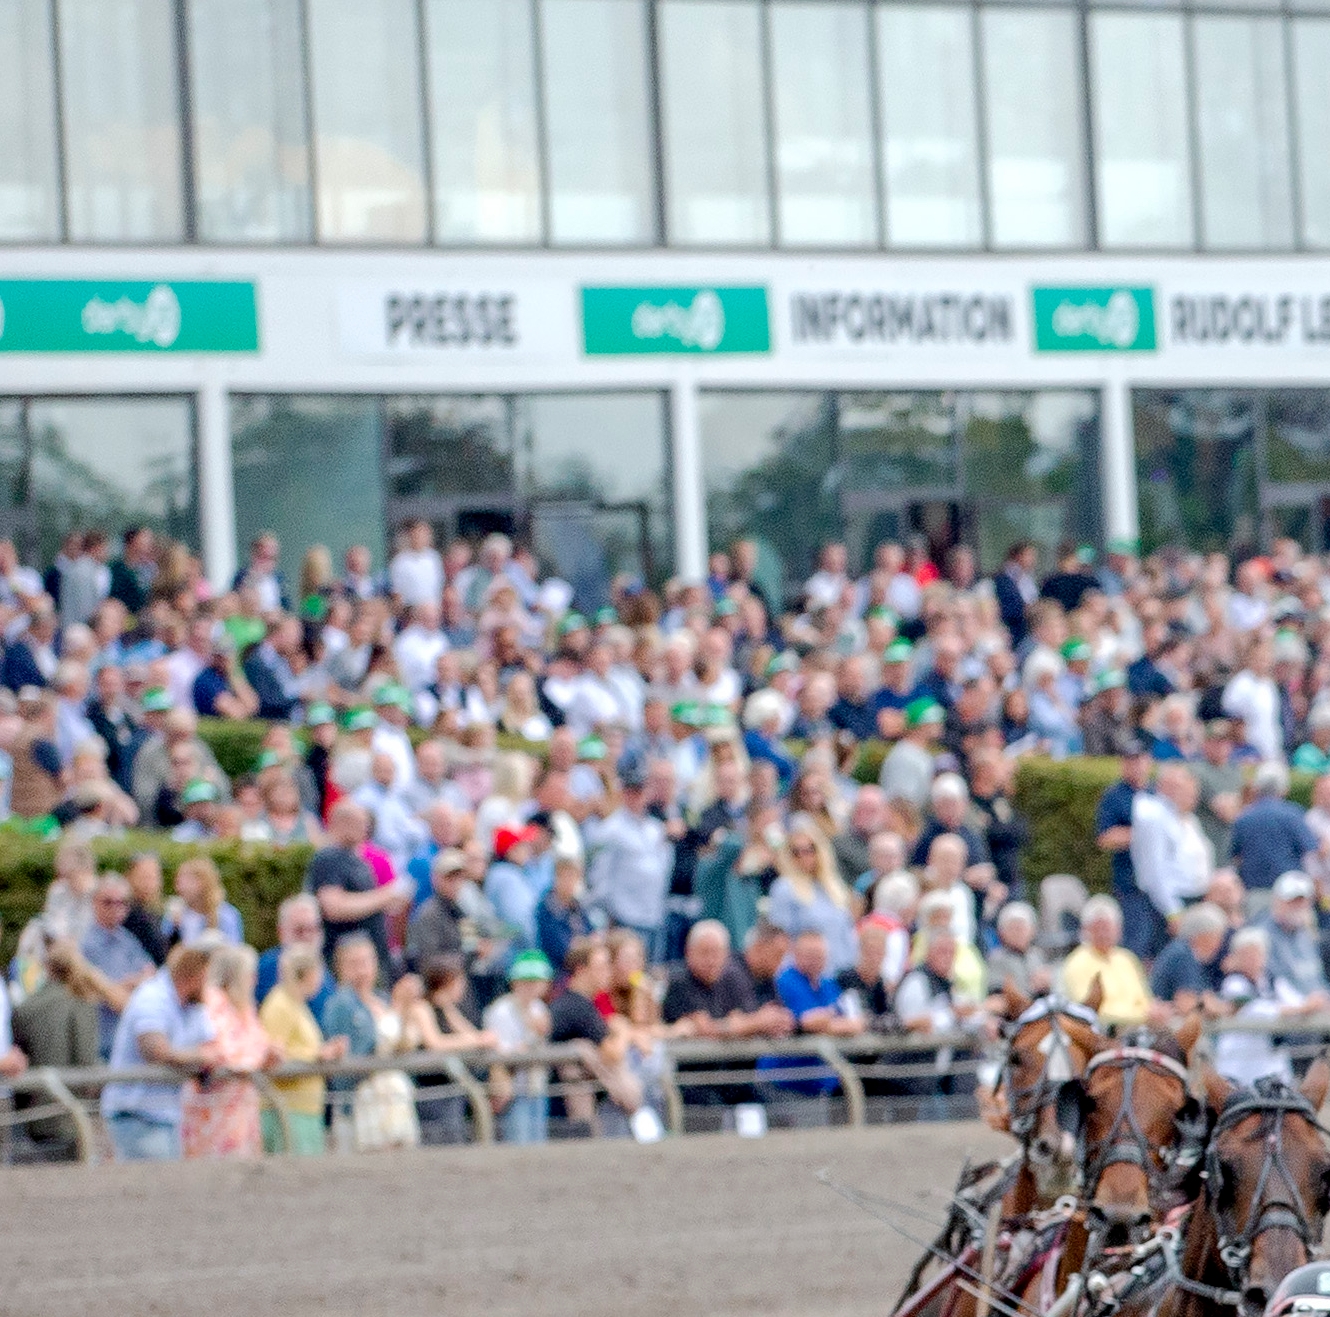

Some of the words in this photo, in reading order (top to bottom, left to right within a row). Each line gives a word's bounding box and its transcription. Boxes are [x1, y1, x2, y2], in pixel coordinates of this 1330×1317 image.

[385, 293, 518, 346] PRESSE
[790, 293, 1013, 343] INFORMATION
[1171, 294, 1292, 344] RUDOLF
